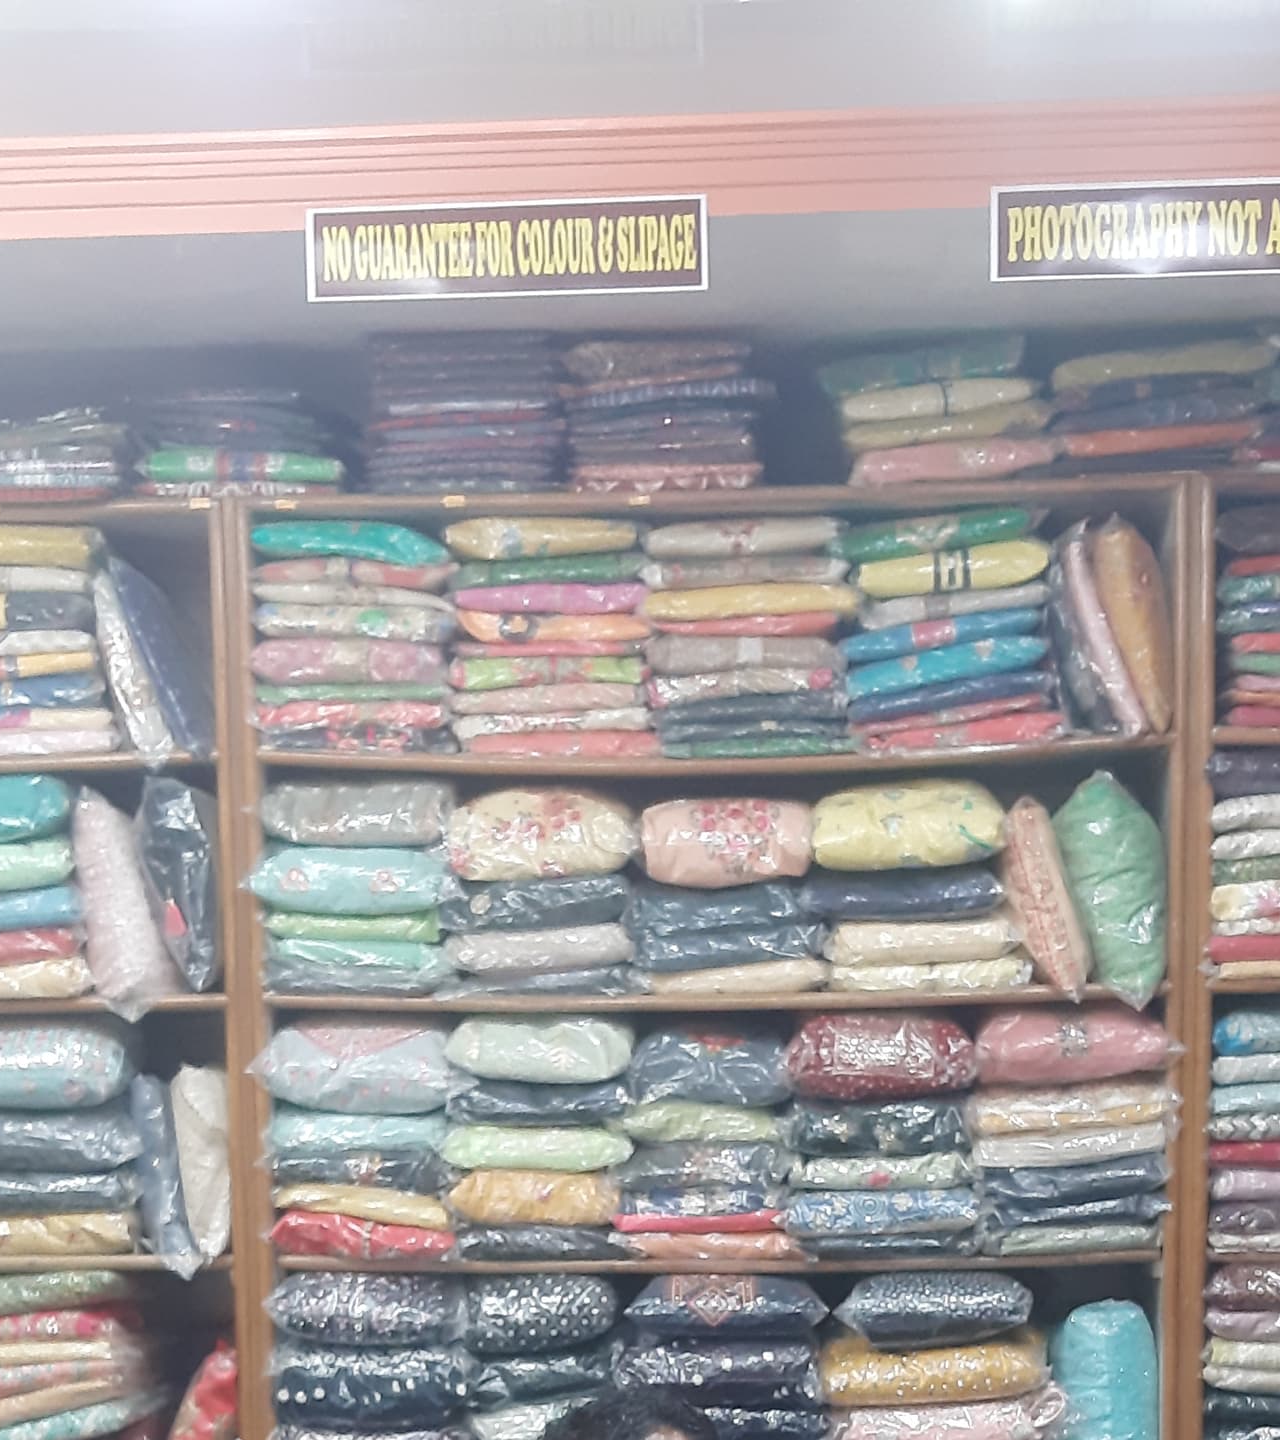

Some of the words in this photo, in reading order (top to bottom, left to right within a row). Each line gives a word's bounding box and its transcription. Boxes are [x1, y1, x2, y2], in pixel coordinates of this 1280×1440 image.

[322, 225, 353, 283] NO
[353, 221, 475, 281] GUARANTEE
[475, 220, 516, 278] FOR
[516, 217, 596, 277] COLOUR
[597, 215, 615, 274] &
[616, 214, 698, 273] SLIPAGE
[1007, 201, 1203, 262] PHOTOGRAPHY
[1206, 199, 1262, 256] NOT
